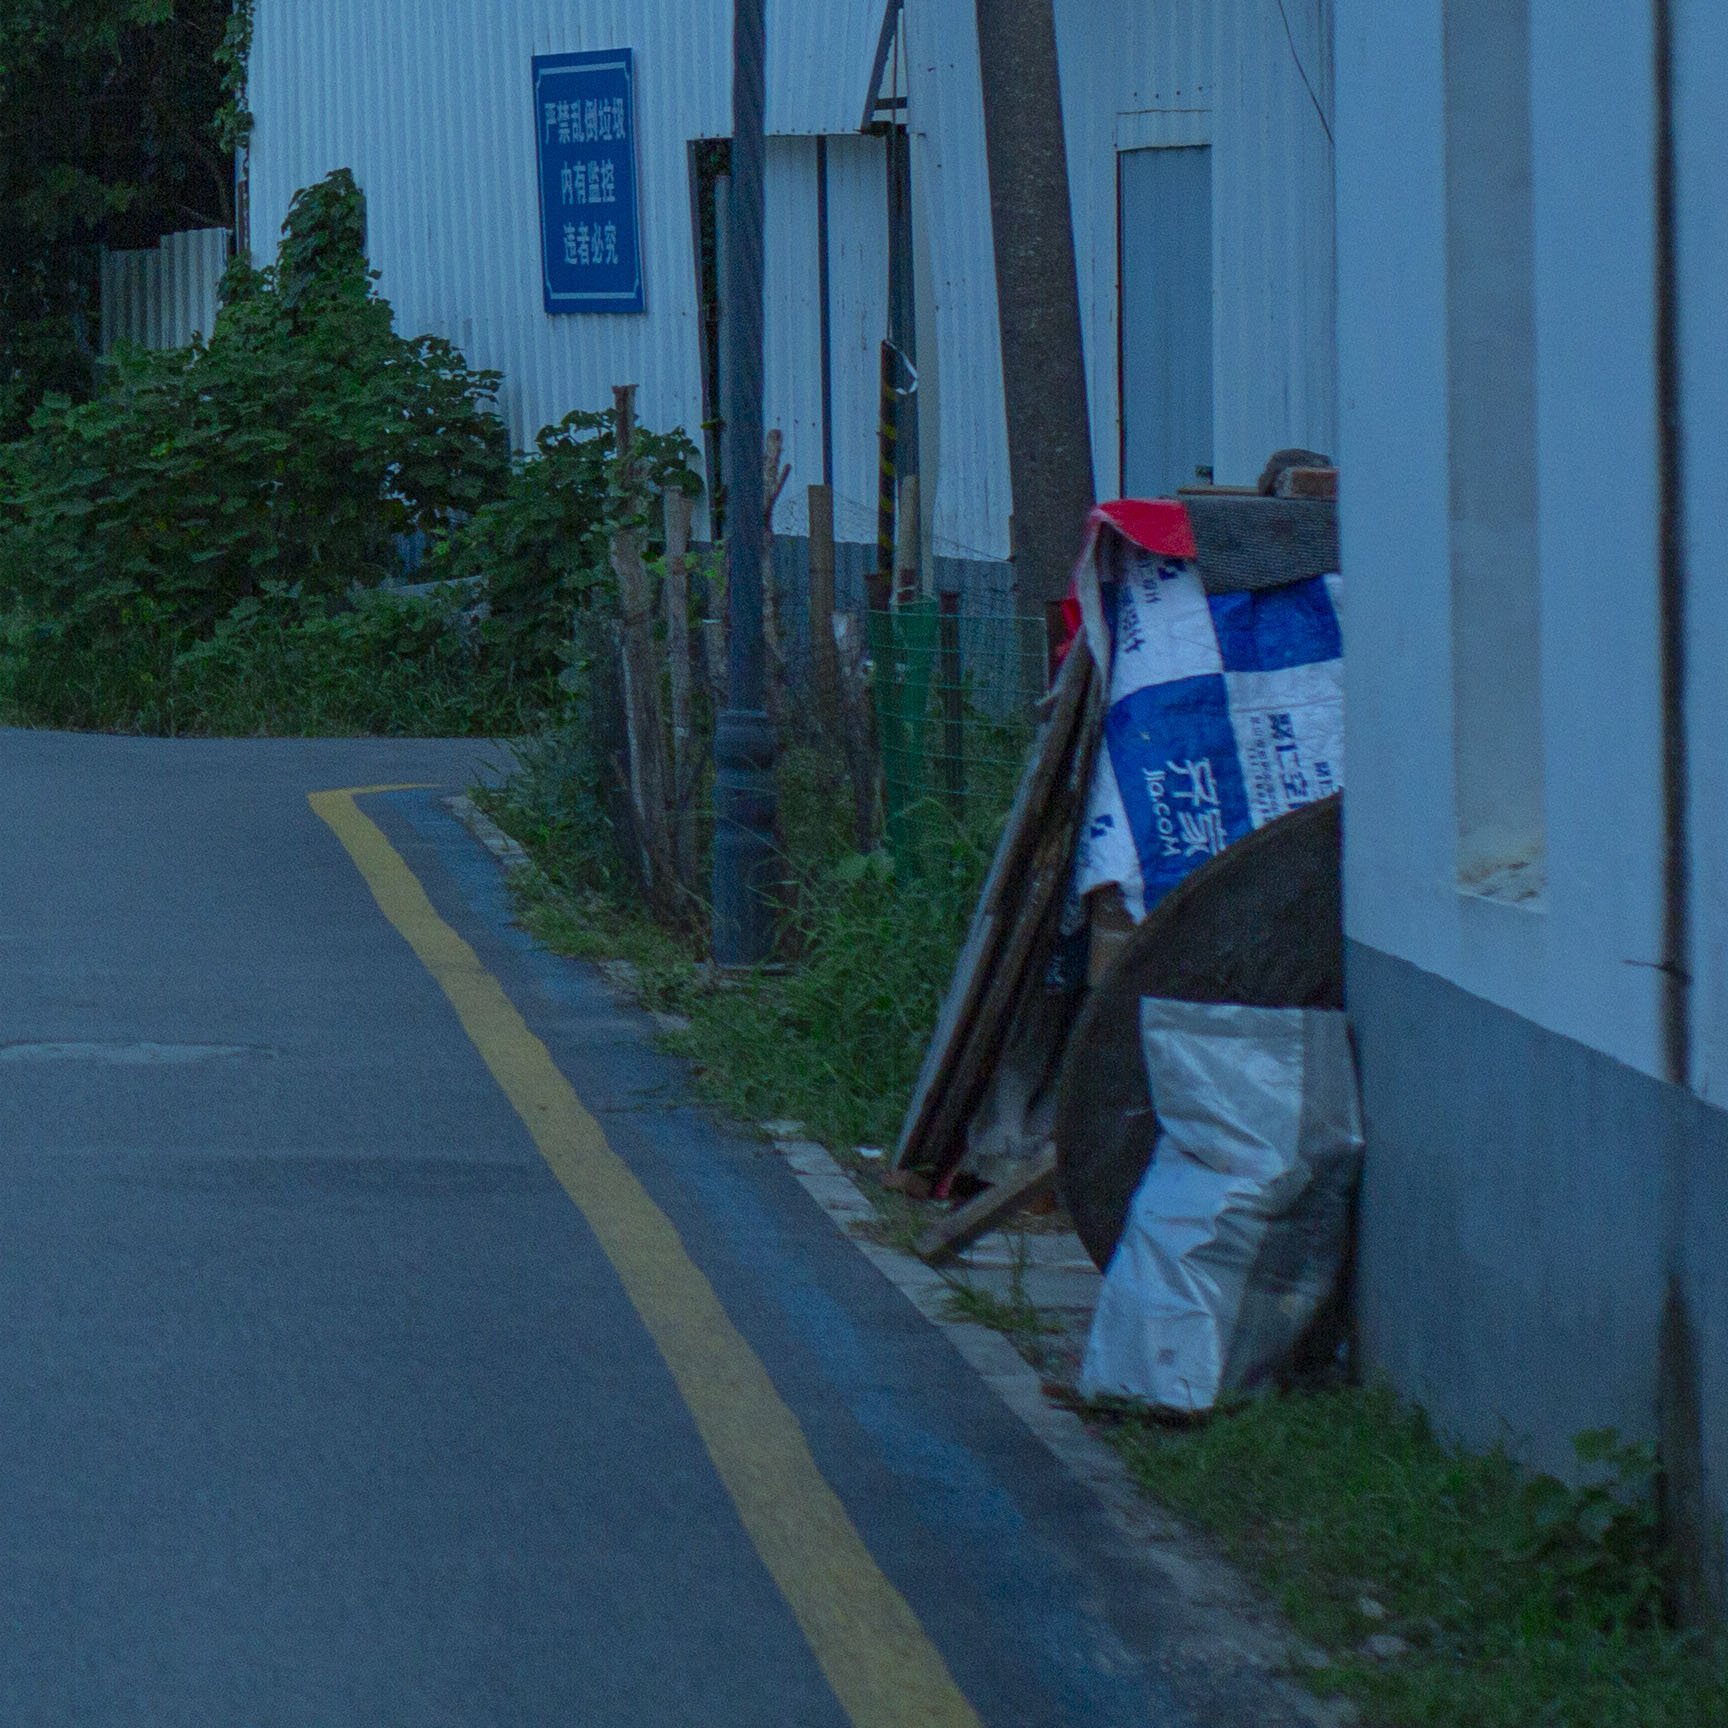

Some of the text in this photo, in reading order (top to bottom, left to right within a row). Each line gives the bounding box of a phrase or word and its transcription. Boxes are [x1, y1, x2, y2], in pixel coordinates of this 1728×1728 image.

[545, 98, 625, 144] 严禁乱倒垃圾
[561, 159, 616, 205] 内有监控
[563, 220, 619, 266] 违者必究
